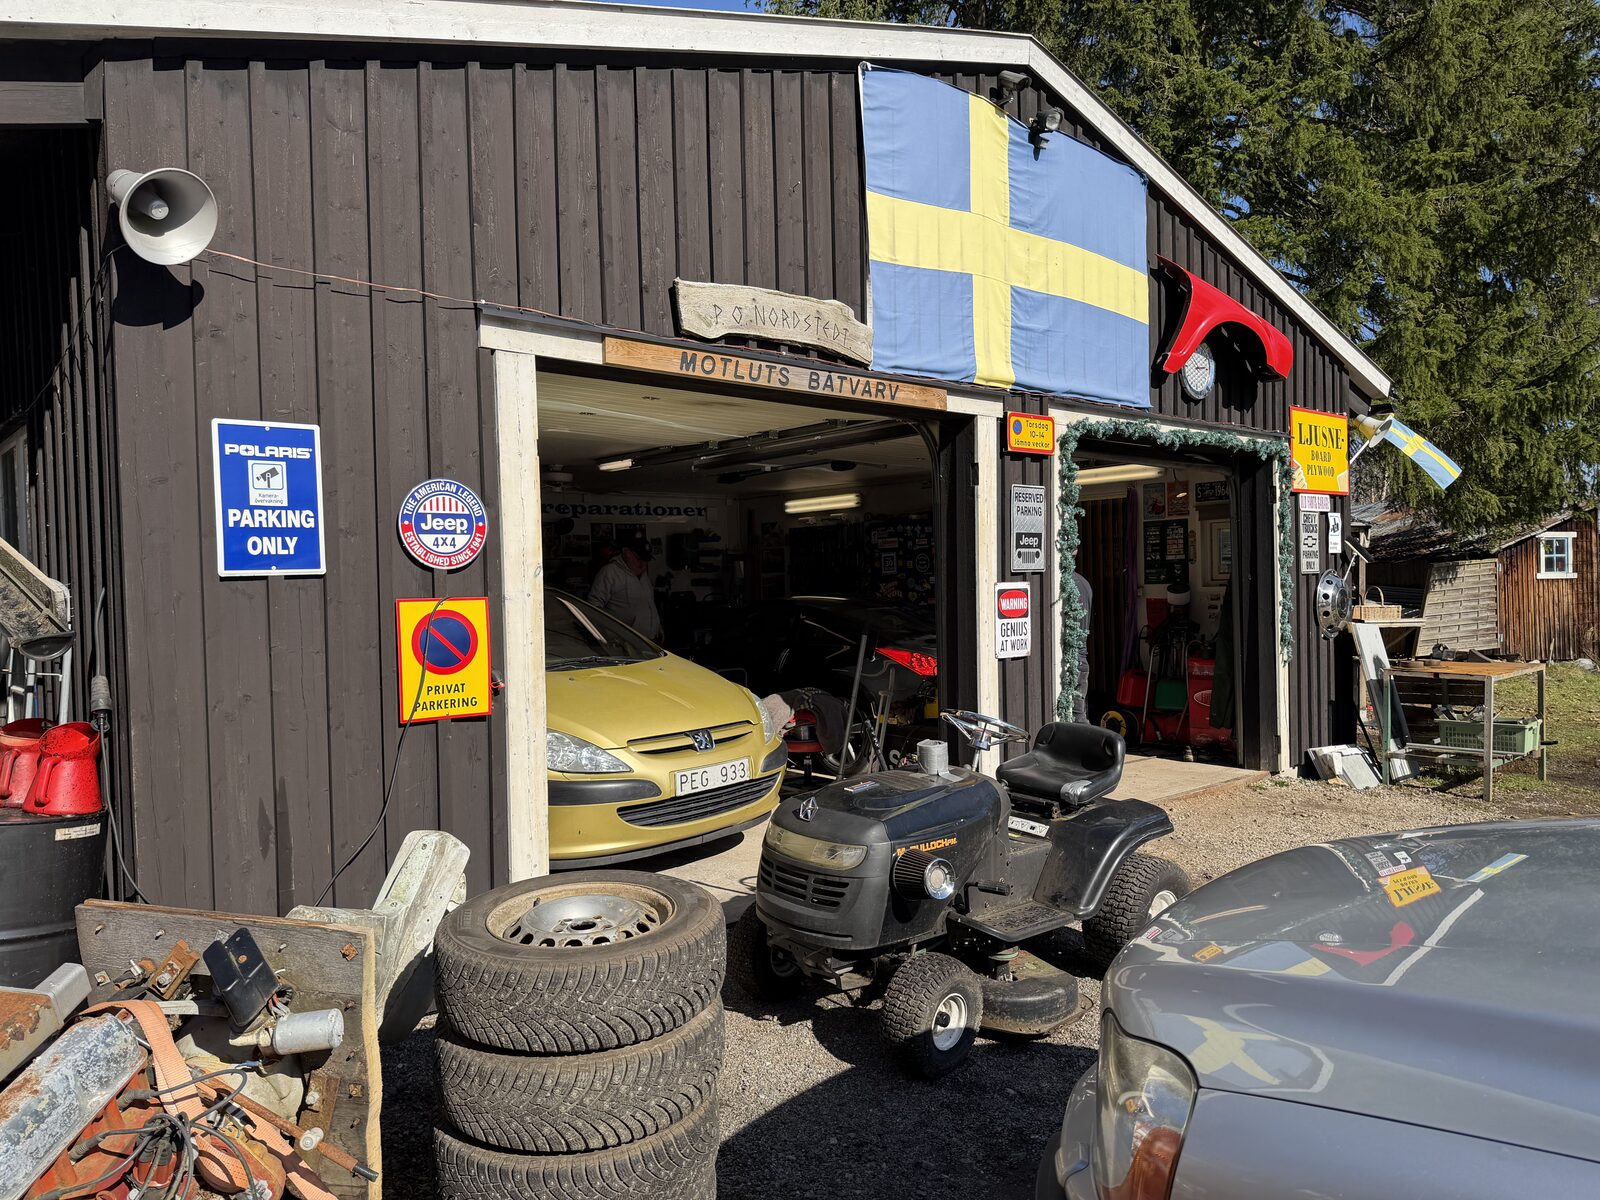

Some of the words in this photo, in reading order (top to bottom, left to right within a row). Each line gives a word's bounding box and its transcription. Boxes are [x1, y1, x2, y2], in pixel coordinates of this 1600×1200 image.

[755, 305, 849, 346] NORDSTEDT
[680, 351, 790, 386] MOTLUTS
[1026, 420, 1048, 431] Torsdag
[1030, 430, 1045, 438] 10-14
[224, 443, 311, 459] POLARIS
[1311, 450, 1331, 462] BOARD
[1307, 464, 1334, 477] PLYWOOD
[403, 498, 417, 515] THE
[414, 482, 457, 500] AMERICAN
[458, 488, 483, 517] LEGEND
[1014, 492, 1044, 503] RESERVED
[1016, 506, 1042, 516] PARKING
[228, 509, 315, 528] PARKING
[420, 514, 468, 534] Jeep
[1303, 513, 1316, 523] CHEVY
[1301, 523, 1318, 533] TRUCKS
[247, 536, 298, 555] ONLY
[1020, 534, 1039, 547] Jeep
[404, 531, 450, 566] ESTABLISHED
[451, 551, 473, 567] SINCE
[471, 534, 483, 550] 1941
[1302, 550, 1318, 559] PARKING
[1306, 561, 1315, 570] ONLY
[1000, 598, 1028, 610] WARNING
[1000, 622, 1028, 637] GENIUS
[1000, 640, 1008, 652] AT
[1010, 638, 1028, 651] WORK
[427, 683, 465, 695] PRIVAT
[414, 697, 478, 712] PARKERING
[680, 770, 708, 792] PEG
[720, 762, 746, 783] 933
